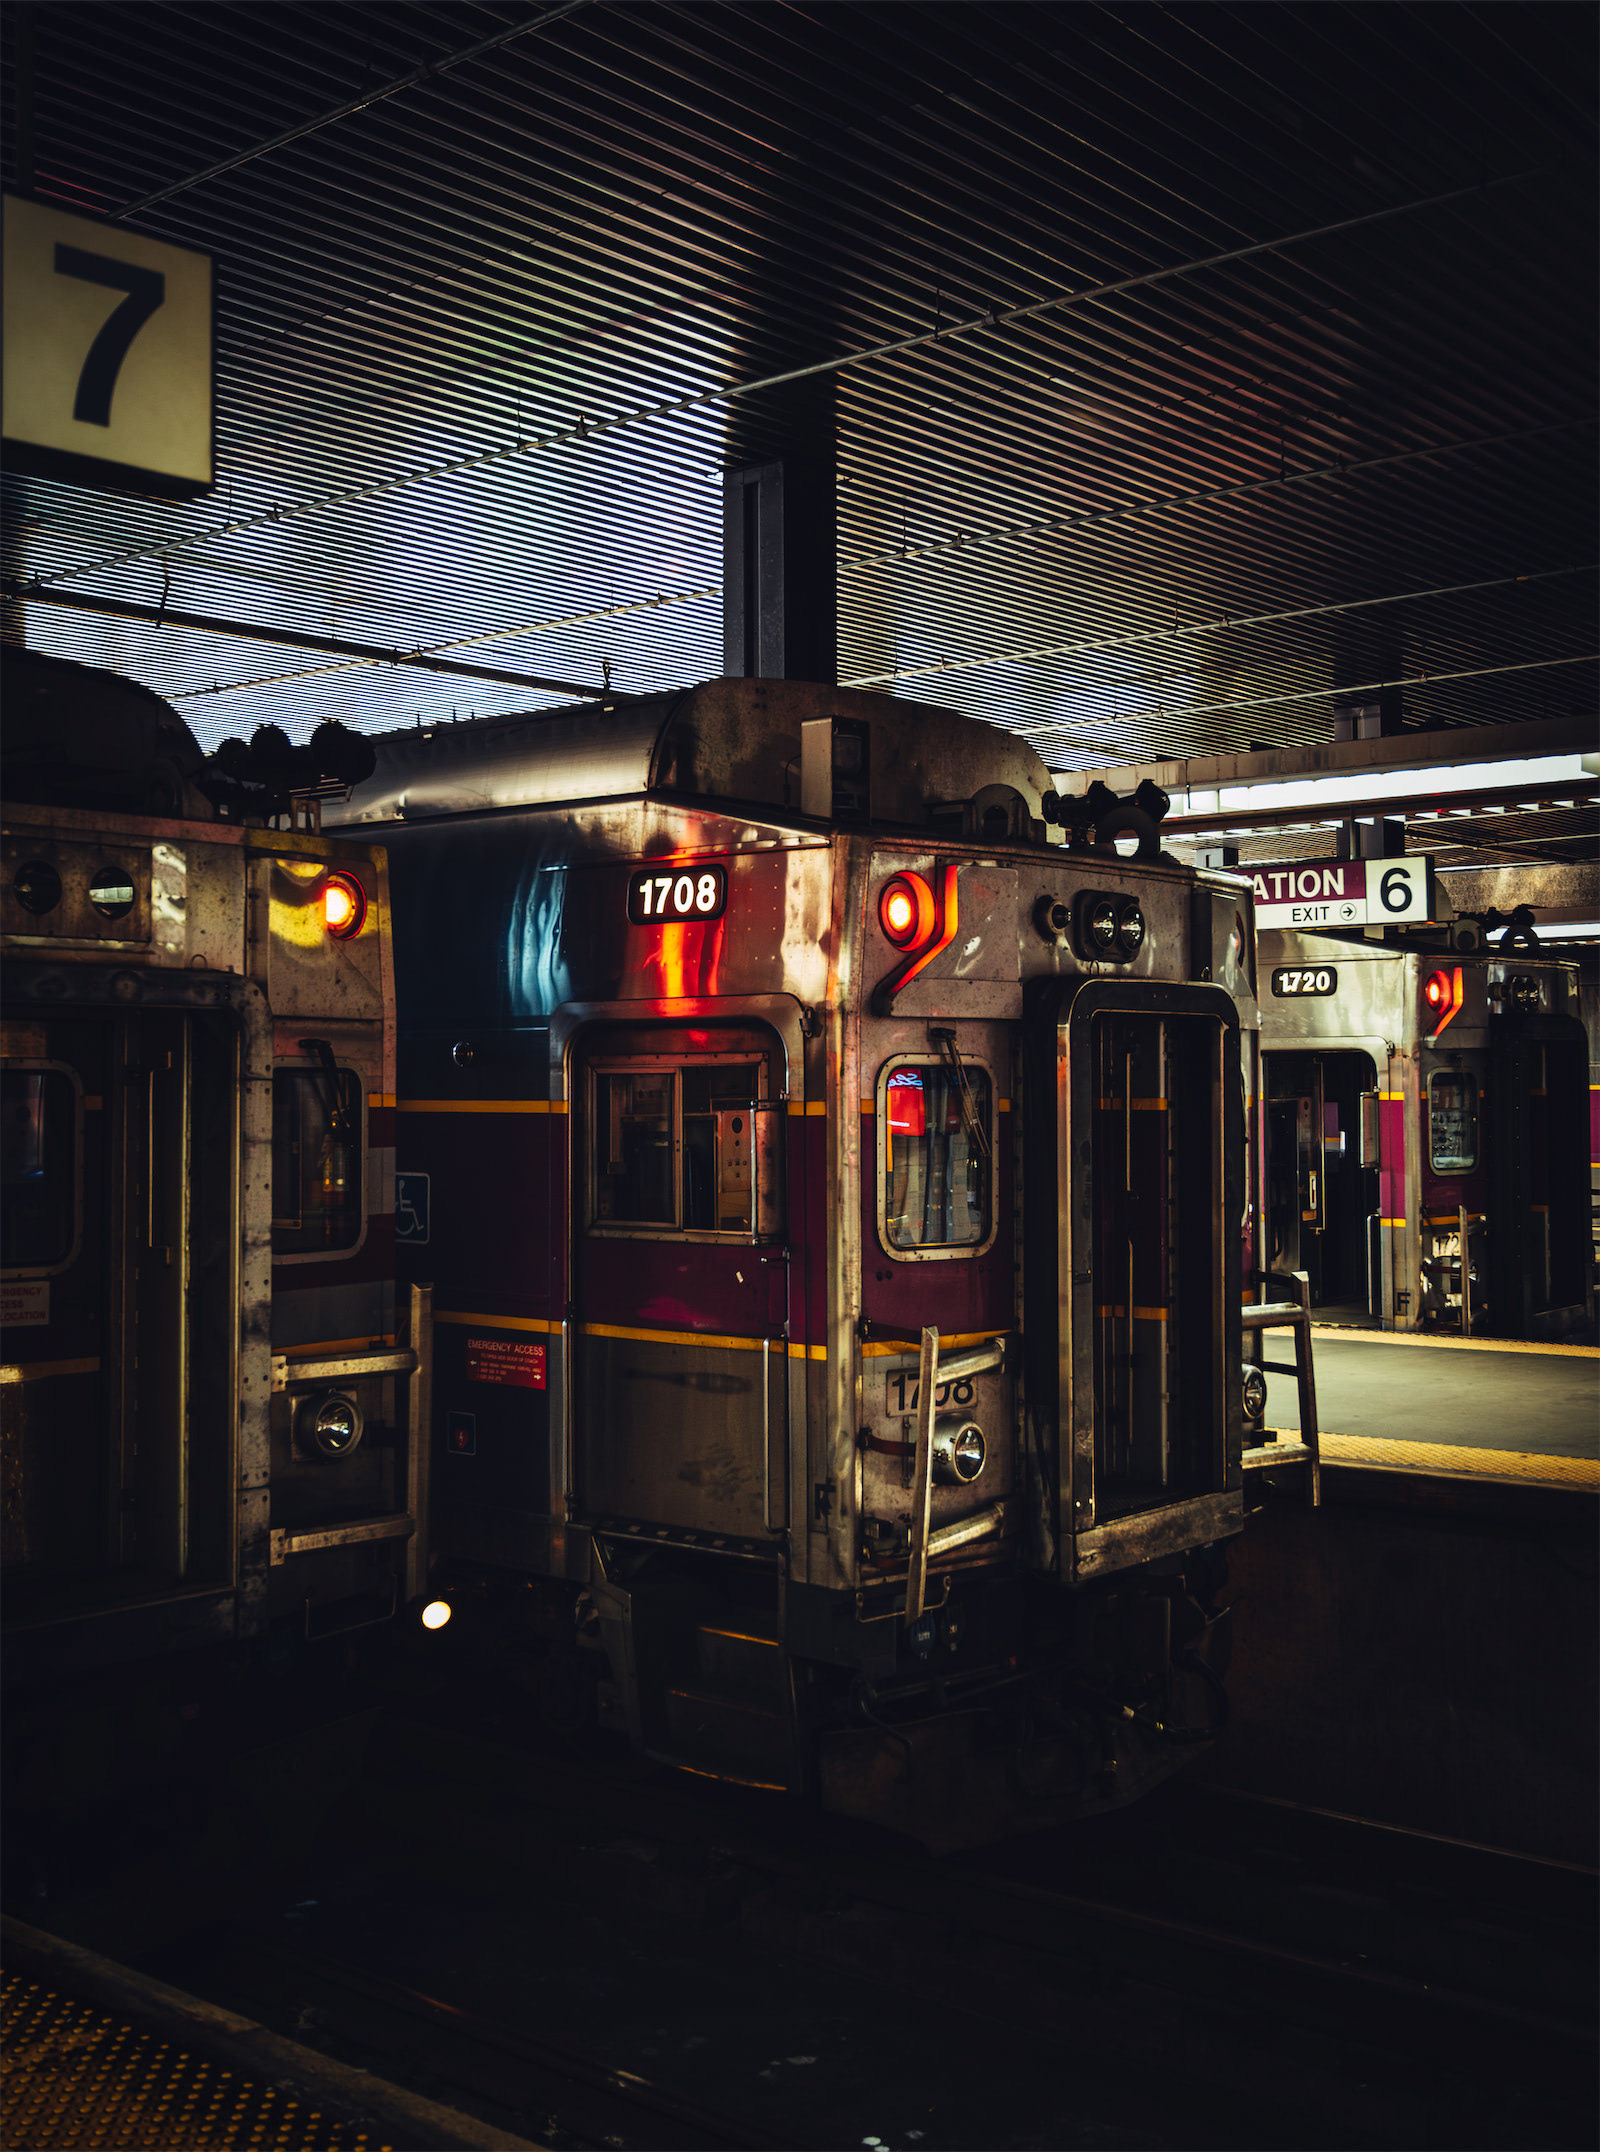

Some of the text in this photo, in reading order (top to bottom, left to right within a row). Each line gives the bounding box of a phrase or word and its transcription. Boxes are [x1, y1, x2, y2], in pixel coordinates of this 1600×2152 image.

[54, 241, 165, 428] 7
[639, 873, 717, 915] 1708
[1380, 867, 1412, 912] 6
[1292, 906, 1330, 922] EXIT
[1278, 970, 1331, 993] 1720
[1435, 1233, 1460, 1256] 172
[467, 1339, 544, 1356] EMERGENCY ACCESS
